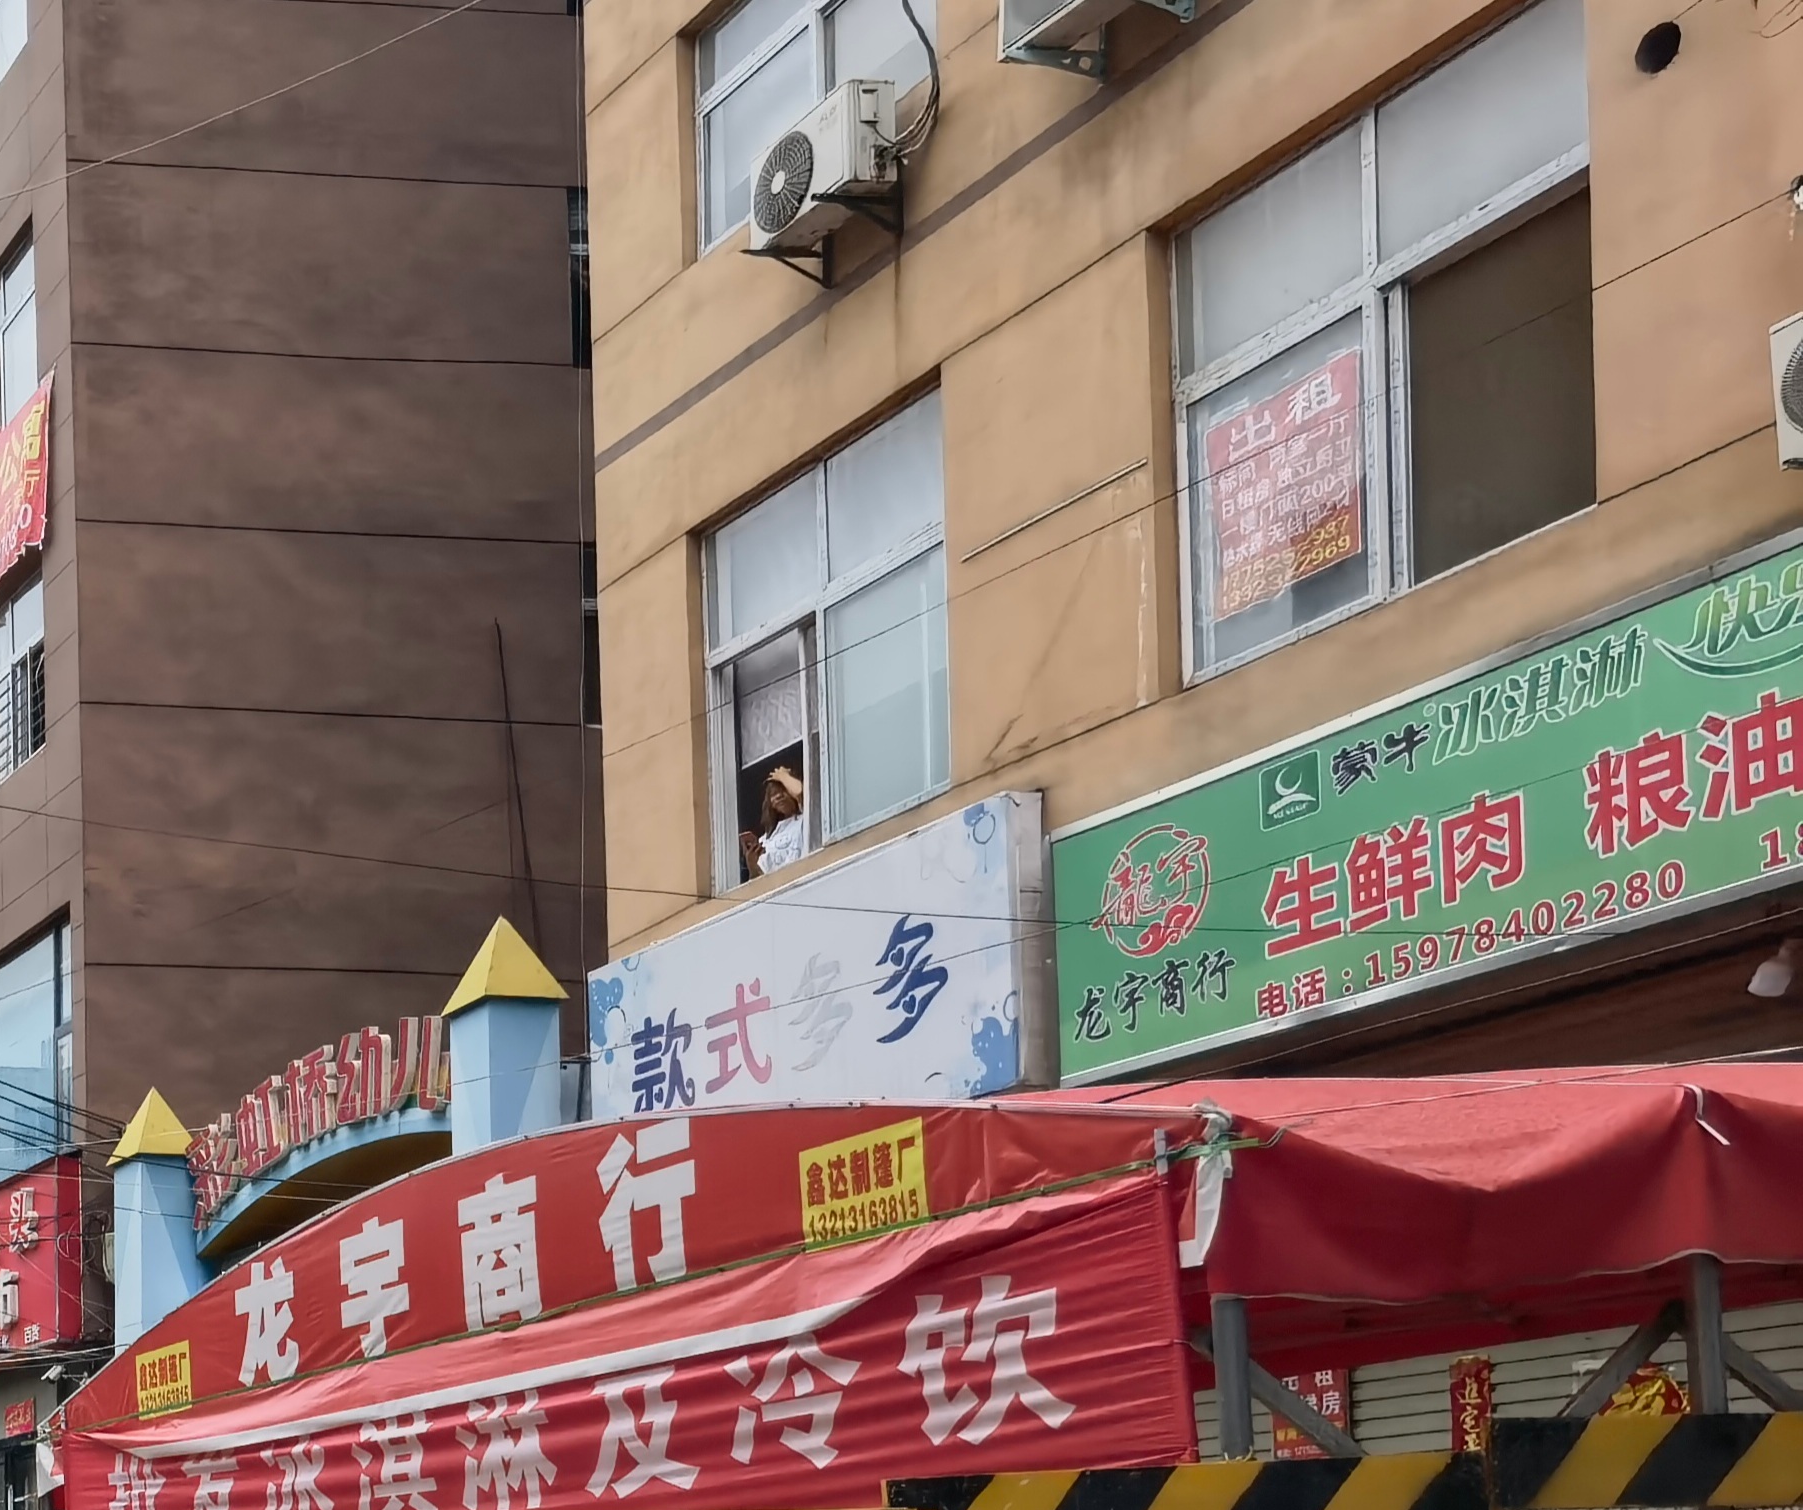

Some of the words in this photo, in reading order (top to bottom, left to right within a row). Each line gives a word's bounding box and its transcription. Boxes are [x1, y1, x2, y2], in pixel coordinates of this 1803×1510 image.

[1228, 372, 1342, 465] 出租
[1331, 720, 1431, 796] 蒙牛
[1432, 624, 1649, 766] 冰淇淋
[1261, 788, 1527, 960] 生鲜肉
[1582, 687, 1803, 858] 粮油
[631, 912, 950, 1113] 款式多多
[1072, 948, 1237, 1043] 龙宇商行
[234, 1117, 696, 1386] 龙宇商行
